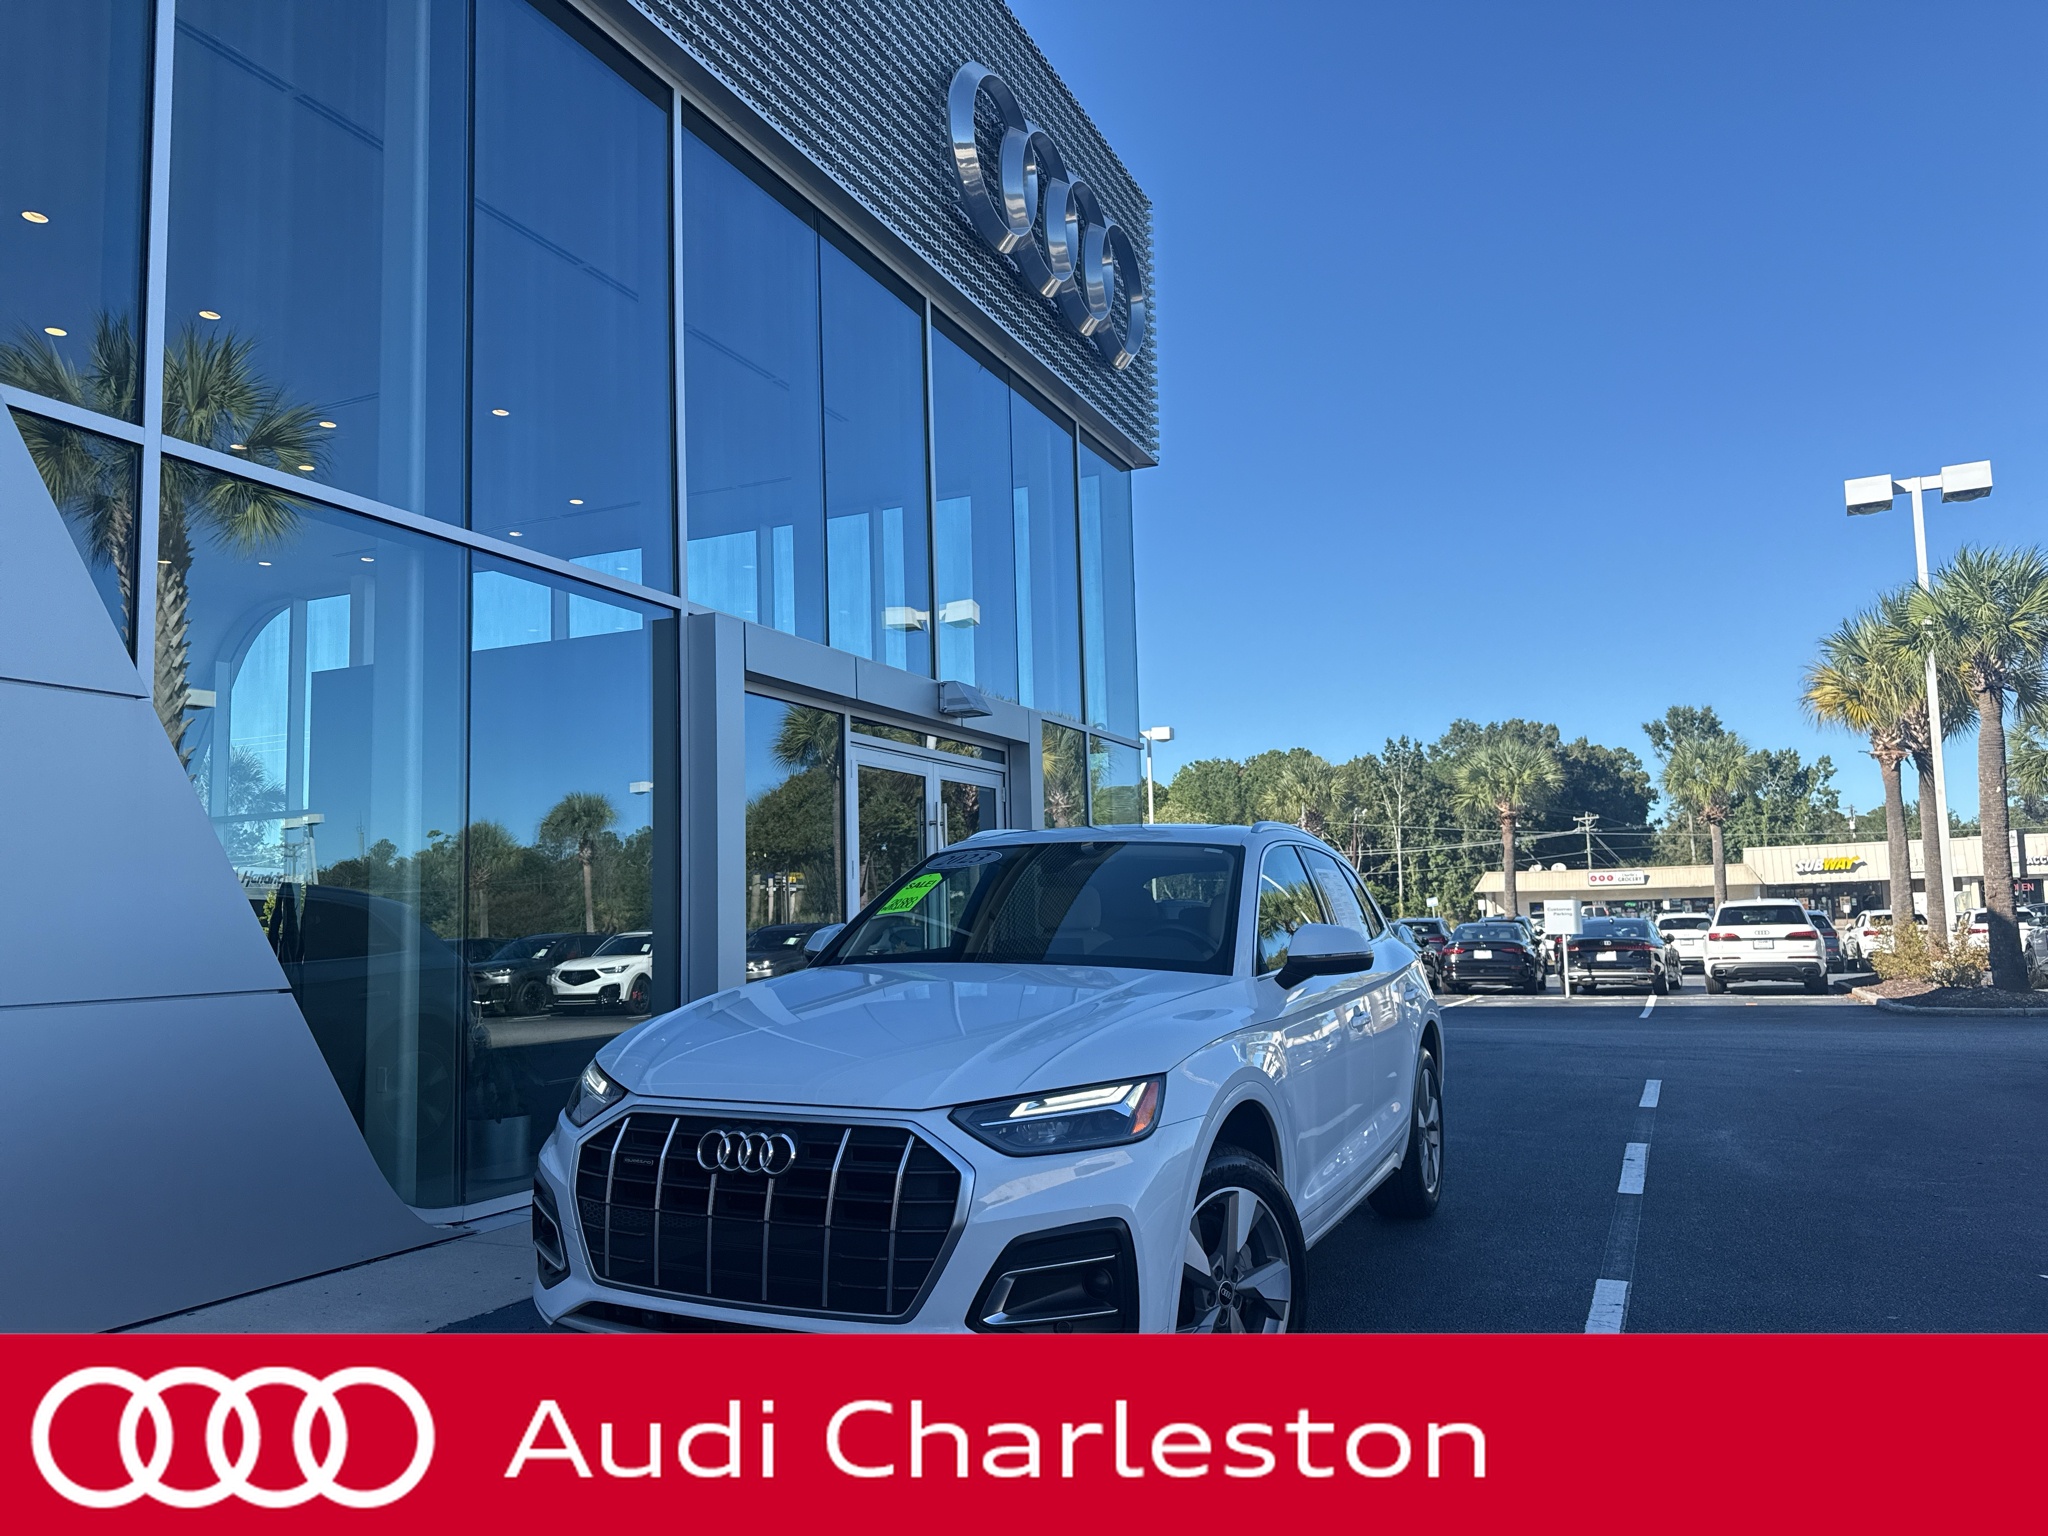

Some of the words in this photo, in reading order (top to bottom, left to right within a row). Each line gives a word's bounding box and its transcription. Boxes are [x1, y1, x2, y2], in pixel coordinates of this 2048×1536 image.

[1795, 855, 1861, 872] SUBWAY
[2026, 855, 2048, 865] ACC
[906, 880, 936, 890] SALE!
